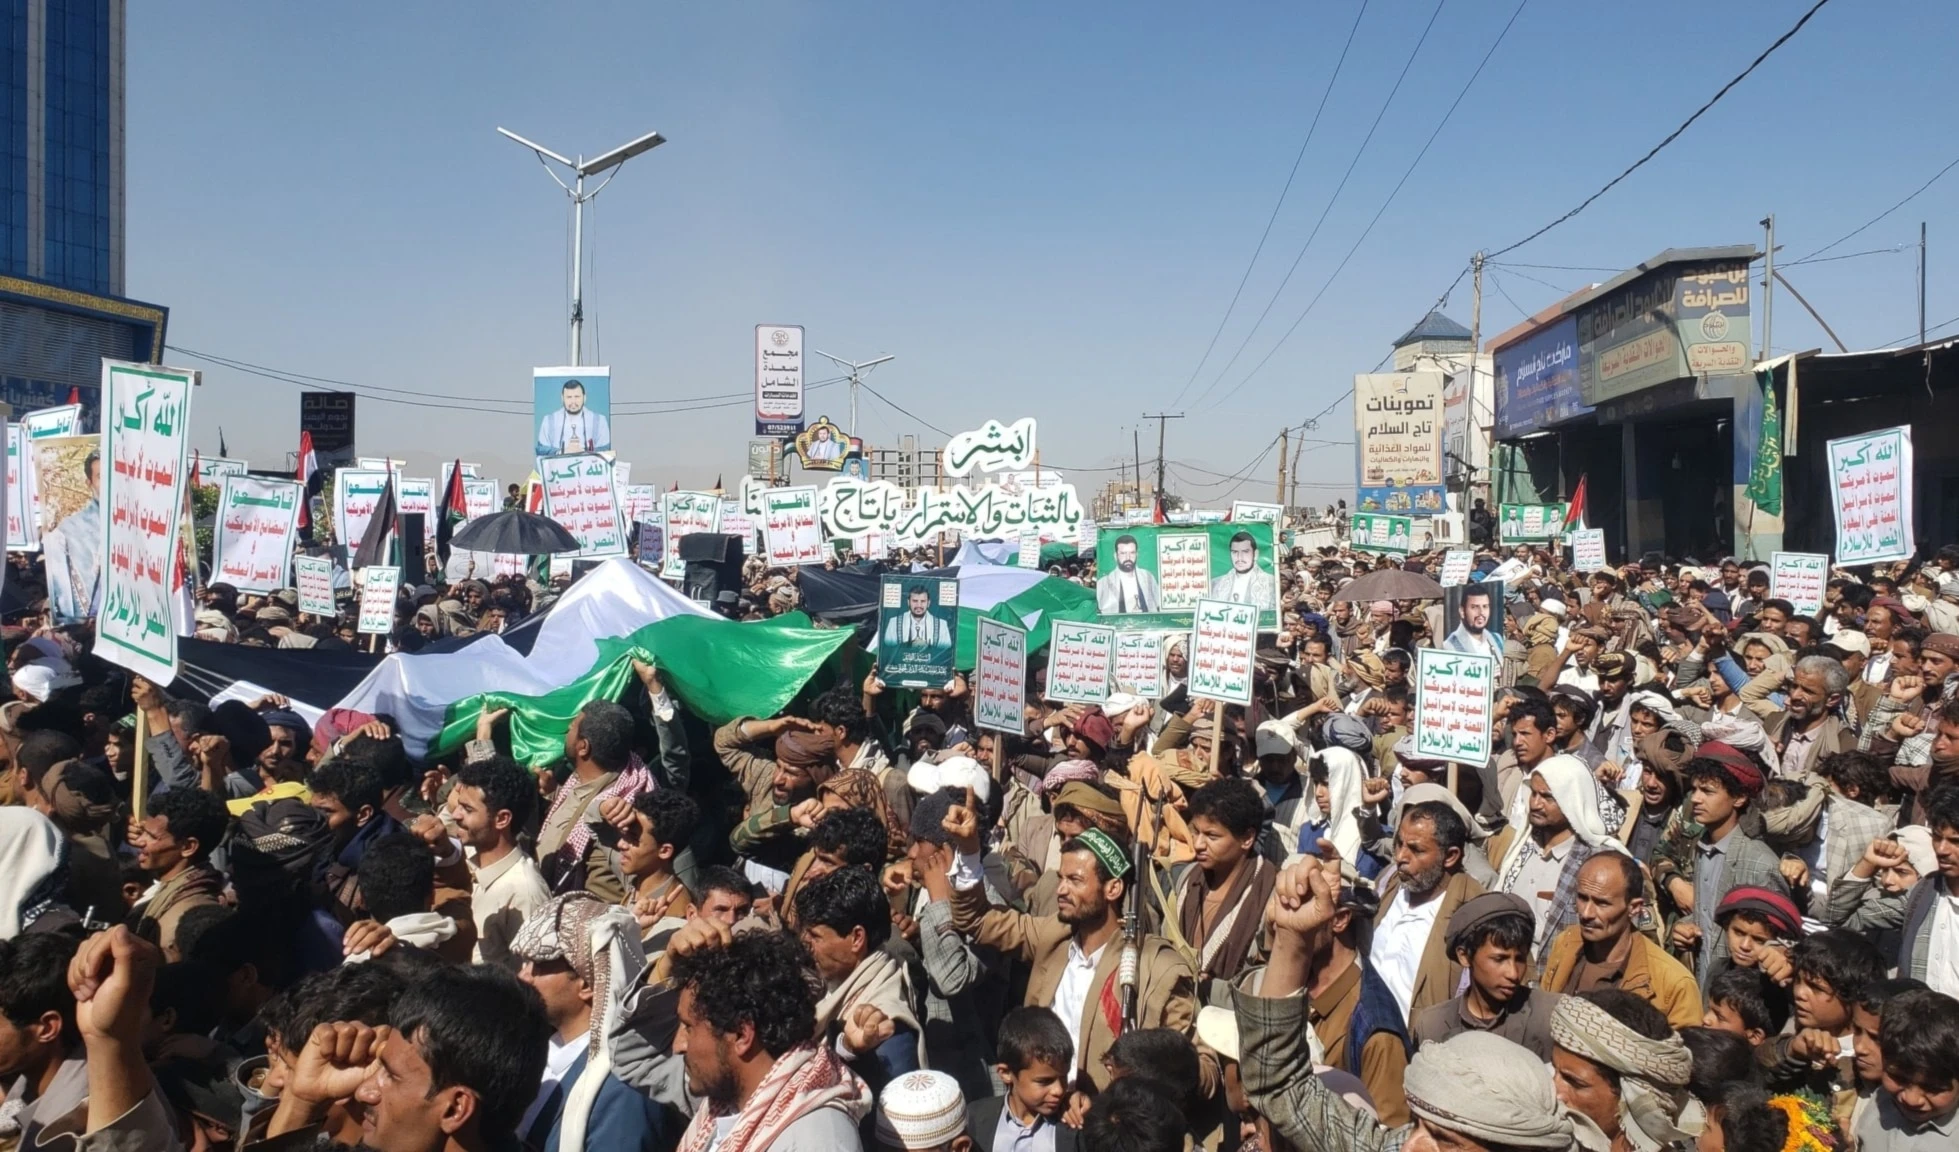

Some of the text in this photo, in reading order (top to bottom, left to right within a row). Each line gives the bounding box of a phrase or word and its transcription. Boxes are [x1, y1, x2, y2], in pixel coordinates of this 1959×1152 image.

[1682, 286, 1748, 310] للصرافة
[763, 349, 799, 361] مجمع
[763, 361, 799, 372] صعدة
[761, 376, 799, 389] الشامل
[114, 380, 183, 442] الله أكبر
[1365, 394, 1435, 415] تموينات
[1367, 421, 1433, 439] تاج السلام
[1368, 443, 1432, 455] للمواد الغذائية
[1837, 439, 1898, 473] الله أكبر
[145, 457, 178, 491] الموت
[548, 458, 609, 484] الله أكبر
[1872, 465, 1899, 484] الموت
[229, 485, 294, 510] قاطعوا
[584, 482, 611, 496] الموت
[1874, 487, 1899, 506] الموت
[587, 499, 614, 514] الموت
[767, 492, 811, 514] قاطعوا
[141, 507, 172, 539] الموت
[259, 517, 289, 539] البضائع
[580, 518, 593, 532] على
[596, 516, 617, 528] اللعنة
[794, 514, 817, 530] البضائع
[1843, 507, 1899, 532] اللعنة على اليهود
[592, 531, 620, 552] النصر
[791, 530, 796, 542] و
[1876, 526, 1902, 553] النصر
[250, 540, 257, 555] و
[111, 543, 166, 586] اللعنة على اليهود
[140, 596, 170, 642] النصر
[1200, 605, 1233, 625] أكبر
[1233, 609, 1254, 624] الله
[983, 629, 1023, 652] الله أكبر
[1059, 629, 1111, 645] الله أكبر
[1227, 630, 1251, 642] الموت
[1086, 649, 1109, 659] الموت
[1226, 647, 1250, 659] الموت
[1004, 657, 1021, 669] الموت
[1084, 662, 1108, 672] الموت
[1195, 658, 1249, 675] اللعنة على اليهود
[1424, 657, 1489, 679] الله أكبر
[1004, 674, 1020, 686] الموت
[1054, 671, 1107, 683] اللعنة على اليهود
[1221, 676, 1247, 693] النصر
[981, 685, 1021, 703] اللعنة على اليهود
[1081, 685, 1105, 698] النصر
[1423, 680, 1487, 698] الموت لأمريكا
[1002, 705, 1020, 724] النصر
[1422, 698, 1487, 716] الموت لإسرائيل
[1421, 716, 1486, 733] اللعنة على اليهود
[1420, 731, 1485, 754] النصر للإسلام
